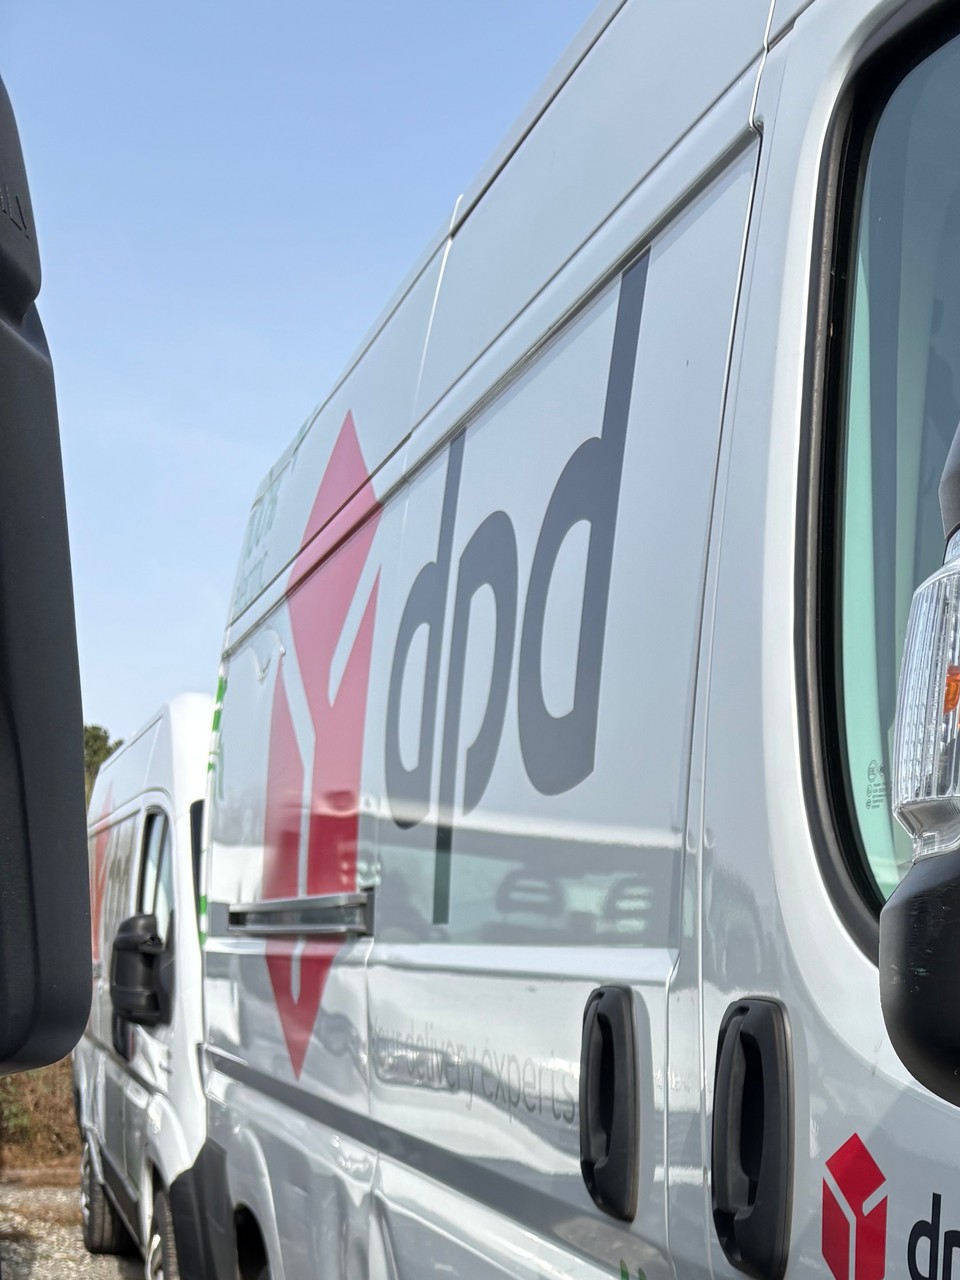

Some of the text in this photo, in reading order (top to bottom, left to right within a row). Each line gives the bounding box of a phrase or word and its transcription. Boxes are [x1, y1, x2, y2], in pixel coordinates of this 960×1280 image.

[384, 243, 652, 925] dpd
[407, 1018, 477, 1112] delivery
[481, 1047, 577, 1125] experts
